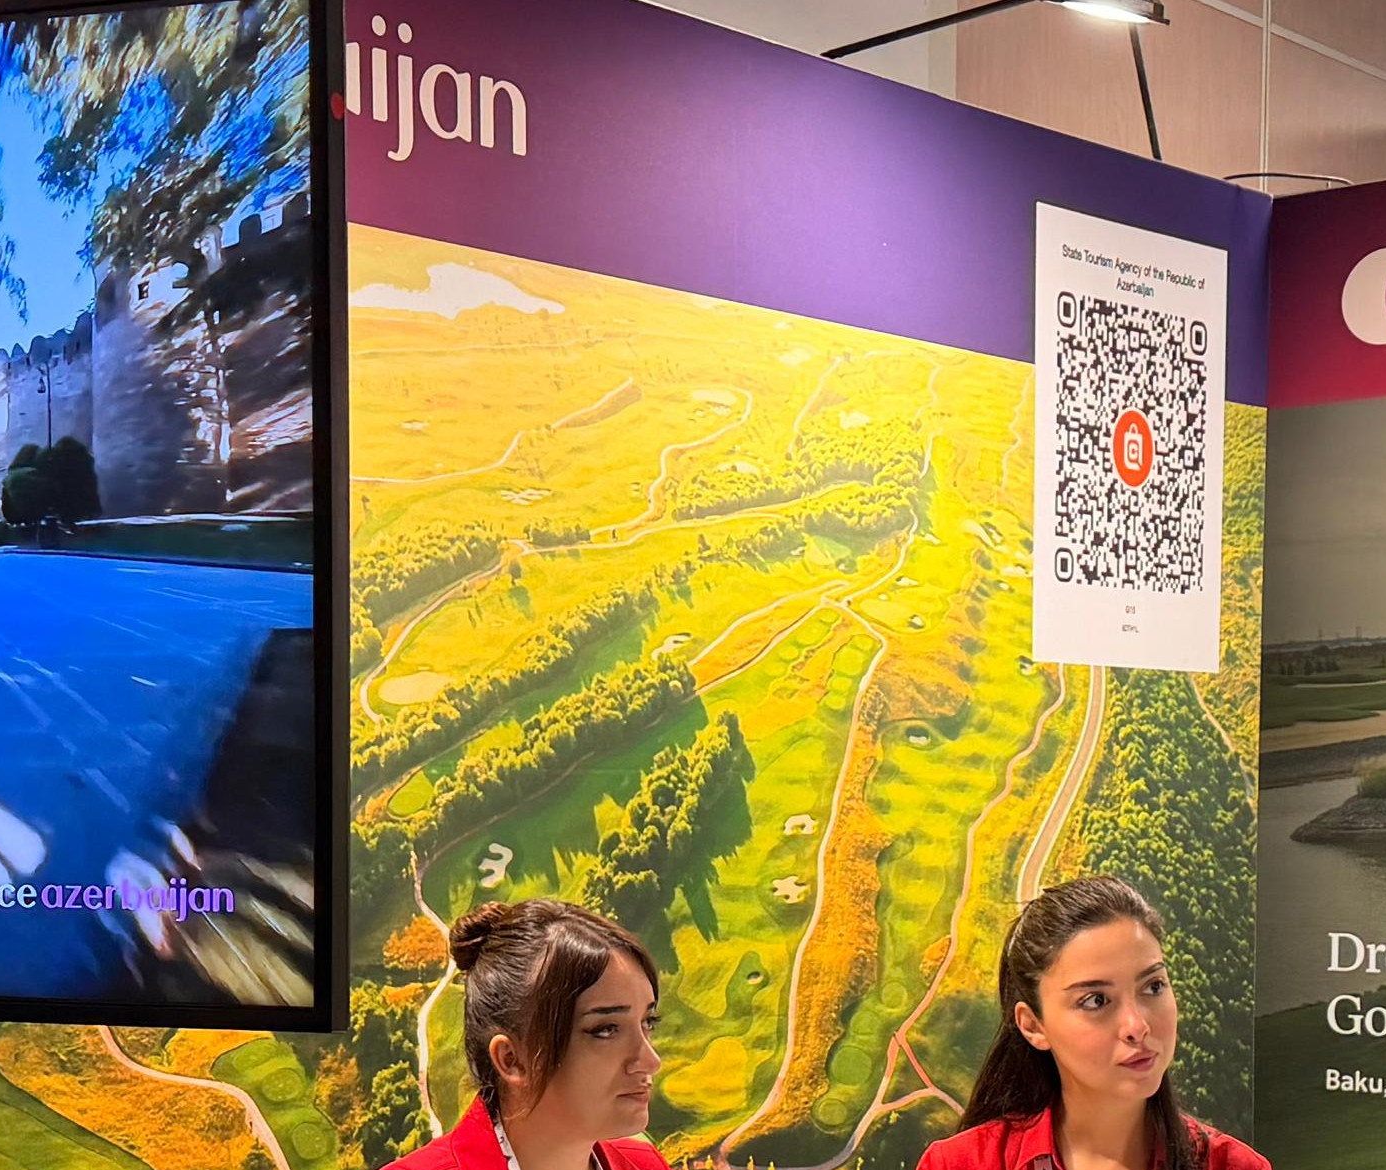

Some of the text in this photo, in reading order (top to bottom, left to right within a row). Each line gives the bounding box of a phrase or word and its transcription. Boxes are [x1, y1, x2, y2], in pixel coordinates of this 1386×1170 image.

[1062, 244, 1082, 261] State
[1083, 249, 1113, 269] Tourism
[1114, 258, 1143, 278] Agency
[1144, 265, 1152, 277] of
[1166, 269, 1196, 289] Republic
[1197, 278, 1205, 290] of
[1116, 277, 1155, 298] Azerbaijan
